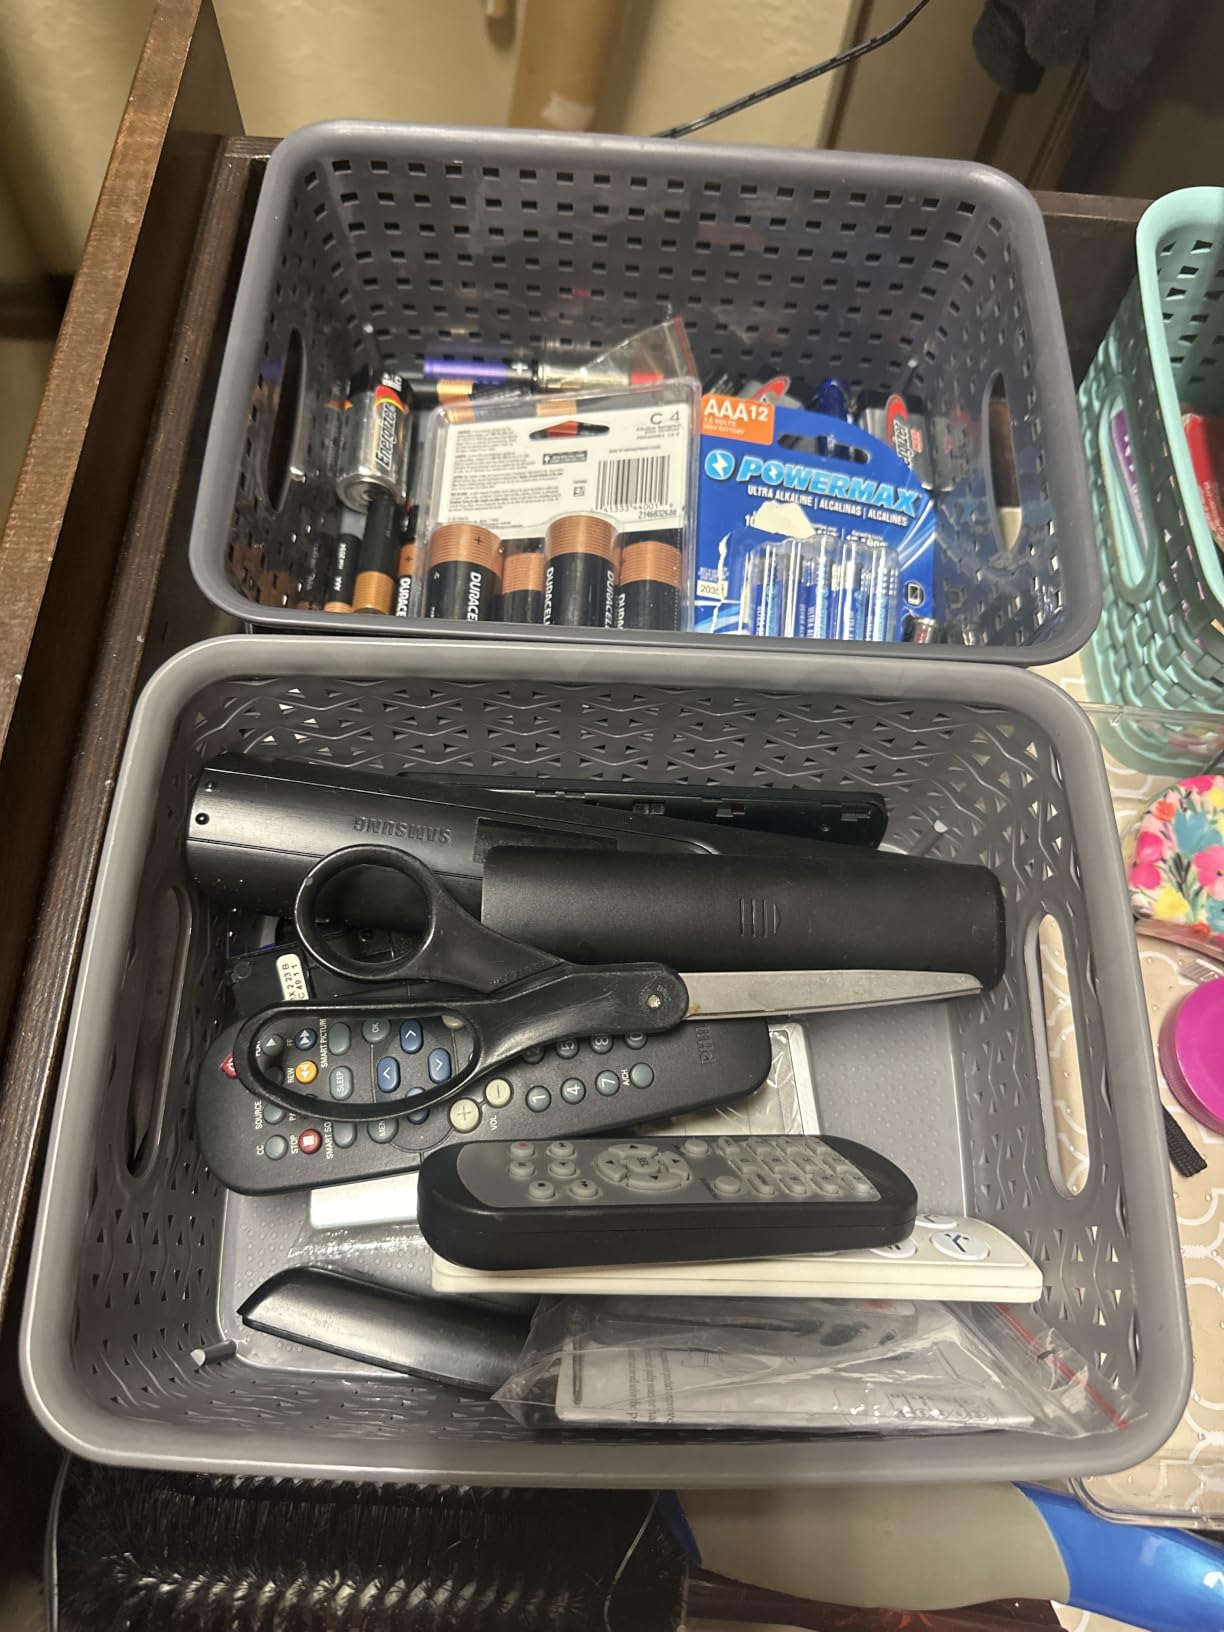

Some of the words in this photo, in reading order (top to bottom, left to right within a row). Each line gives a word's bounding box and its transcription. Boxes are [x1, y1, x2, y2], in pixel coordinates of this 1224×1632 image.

[650, 412, 663, 425] C
[670, 410, 680, 423] 4
[376, 402, 397, 471] Energizer
[736, 455, 919, 517] POWERMAX
[747, 485, 773, 499] ULTRA
[775, 489, 813, 507] ALKALINE
[819, 498, 862, 517] ALCALINAS
[867, 505, 909, 527] ALCALINES
[396, 577, 412, 617] DURACE
[354, 816, 452, 843] SAMSUNG
[371, 1022, 380, 1033] OK
[561, 1040, 575, 1050] 5
[594, 1037, 609, 1046] 8
[320, 1044, 329, 1068] SMART
[287, 1067, 295, 1084] REW
[336, 1071, 345, 1092] SLEEP
[601, 1078, 616, 1087] 7
[566, 1084, 580, 1095] 4
[532, 1095, 546, 1103] 1
[254, 1100, 263, 1130] SOURCE
[490, 1115, 498, 1131] VOL
[256, 1144, 265, 1156] CC
[290, 1134, 299, 1154] STOP
[325, 1134, 334, 1160] SMART
